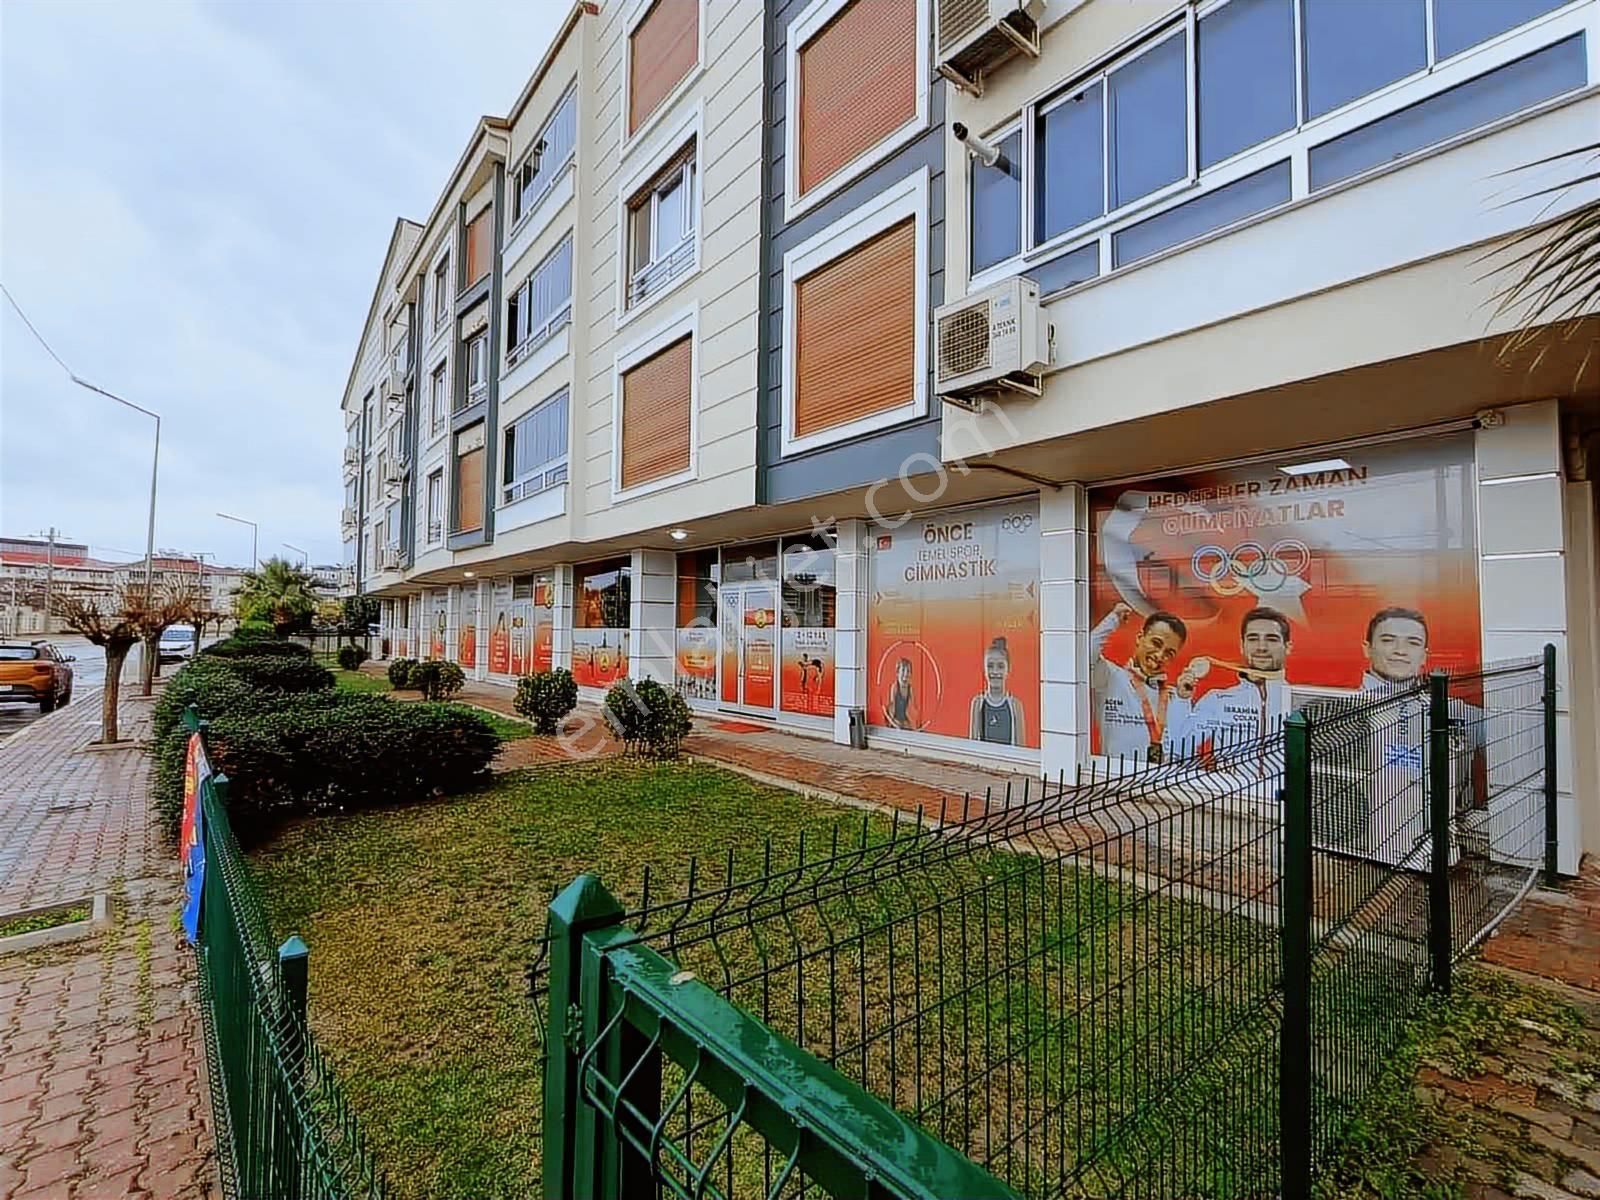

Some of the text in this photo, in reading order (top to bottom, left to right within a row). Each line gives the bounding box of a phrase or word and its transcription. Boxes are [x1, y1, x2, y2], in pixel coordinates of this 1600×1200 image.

[1216, 481, 1262, 504] HER
[1267, 466, 1369, 497] ZAMAN
[924, 522, 973, 544] ÖNCE
[949, 544, 980, 559] SPOR
[904, 555, 996, 582] CİMNASTİK
